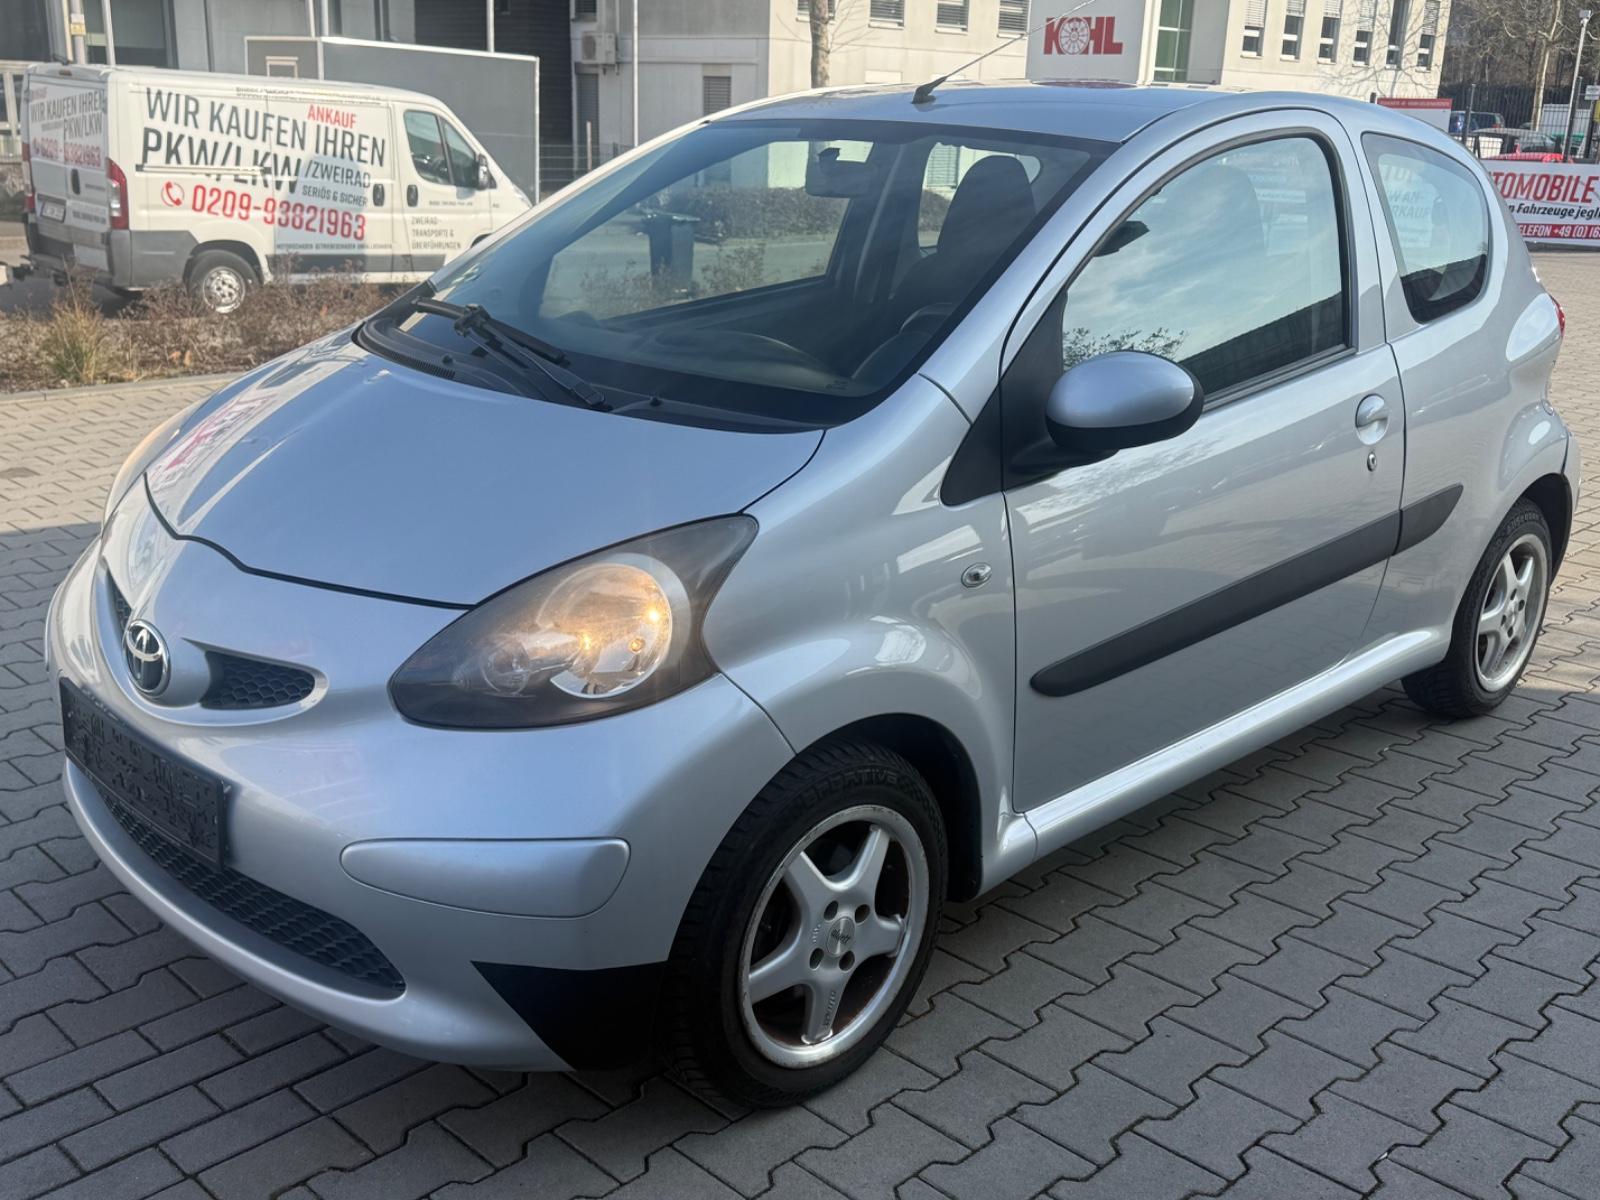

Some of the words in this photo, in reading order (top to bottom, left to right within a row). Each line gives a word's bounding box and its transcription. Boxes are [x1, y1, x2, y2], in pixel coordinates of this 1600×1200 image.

[1043, 16, 1123, 55] KOHL
[146, 87, 200, 129] WIR
[209, 101, 307, 151] KAUFEN
[314, 124, 386, 167] IHREN
[307, 104, 357, 128] ANKAUF
[1488, 172, 1600, 203] TOMOBILE
[339, 192, 368, 208] SICHER
[1517, 203, 1575, 218] Fahrzeuge
[1574, 205, 1600, 220] jegl
[191, 184, 366, 241] 0209-93821963
[412, 228, 448, 238] TRANSPORTE
[1519, 225, 1552, 236] ELEFON
[1588, 226, 1600, 238] 16
